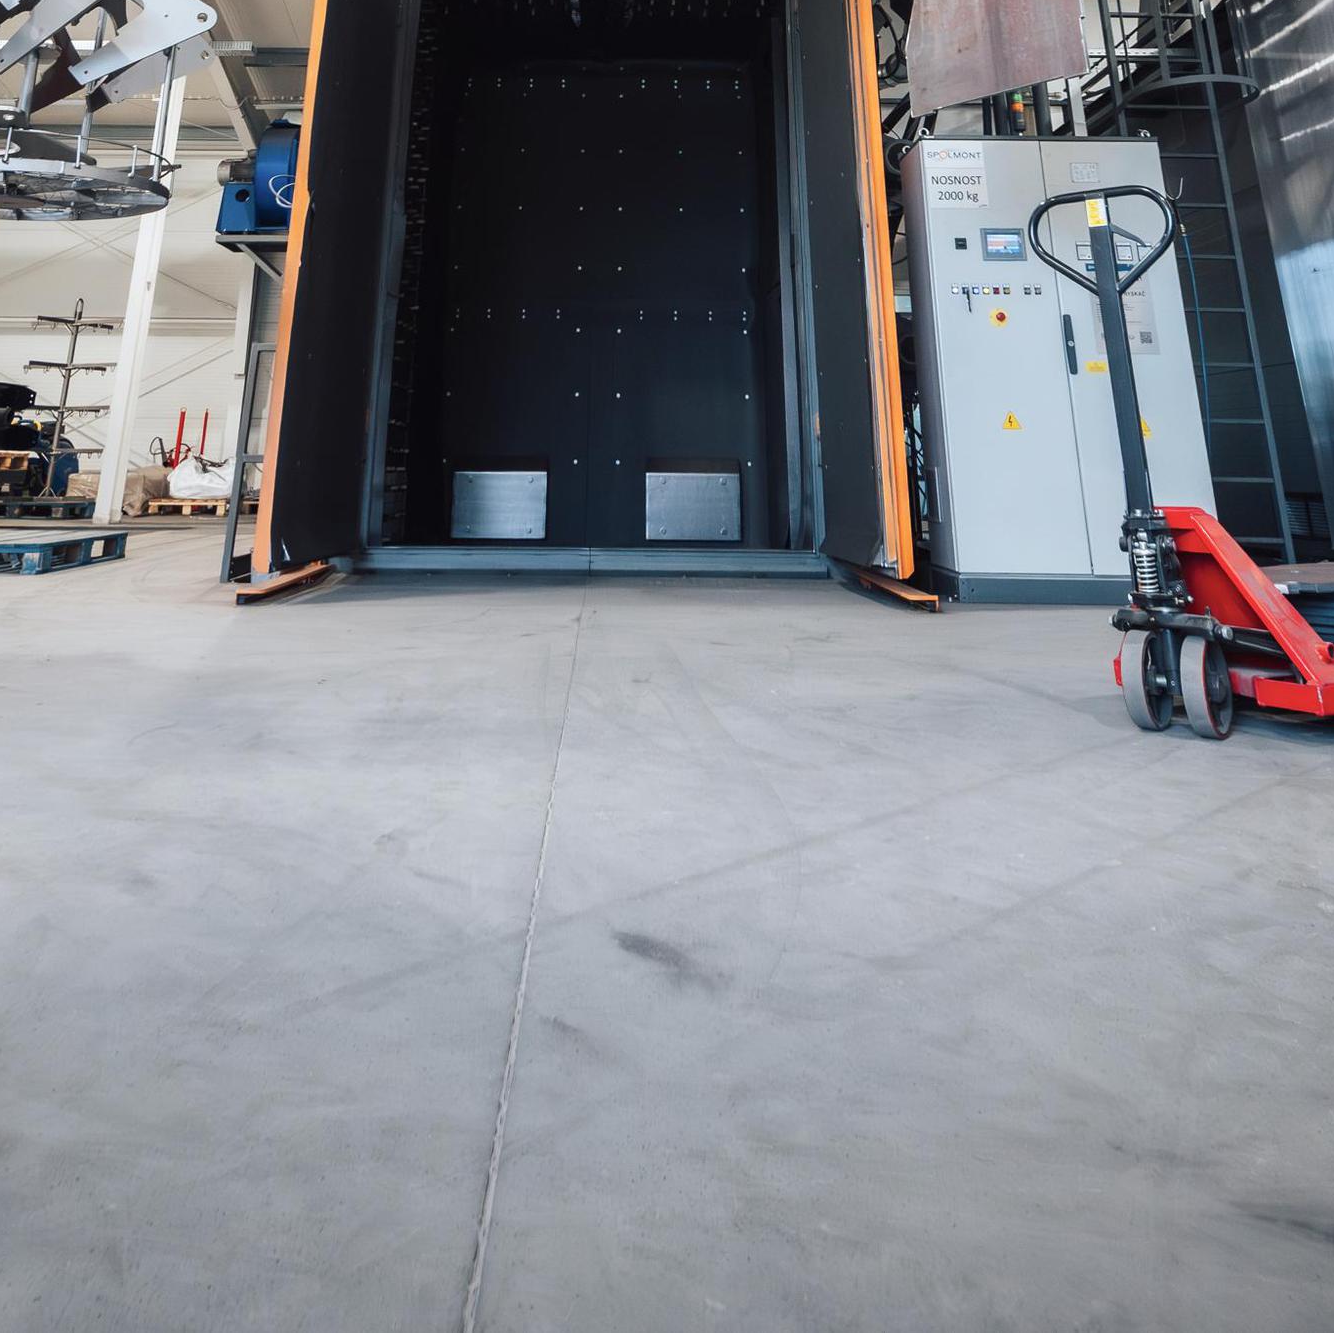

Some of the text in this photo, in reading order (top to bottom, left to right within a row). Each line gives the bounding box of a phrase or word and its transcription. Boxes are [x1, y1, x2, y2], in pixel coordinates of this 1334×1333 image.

[931, 175, 982, 185] NOSNOST
[938, 190, 979, 203] 2000 kg
